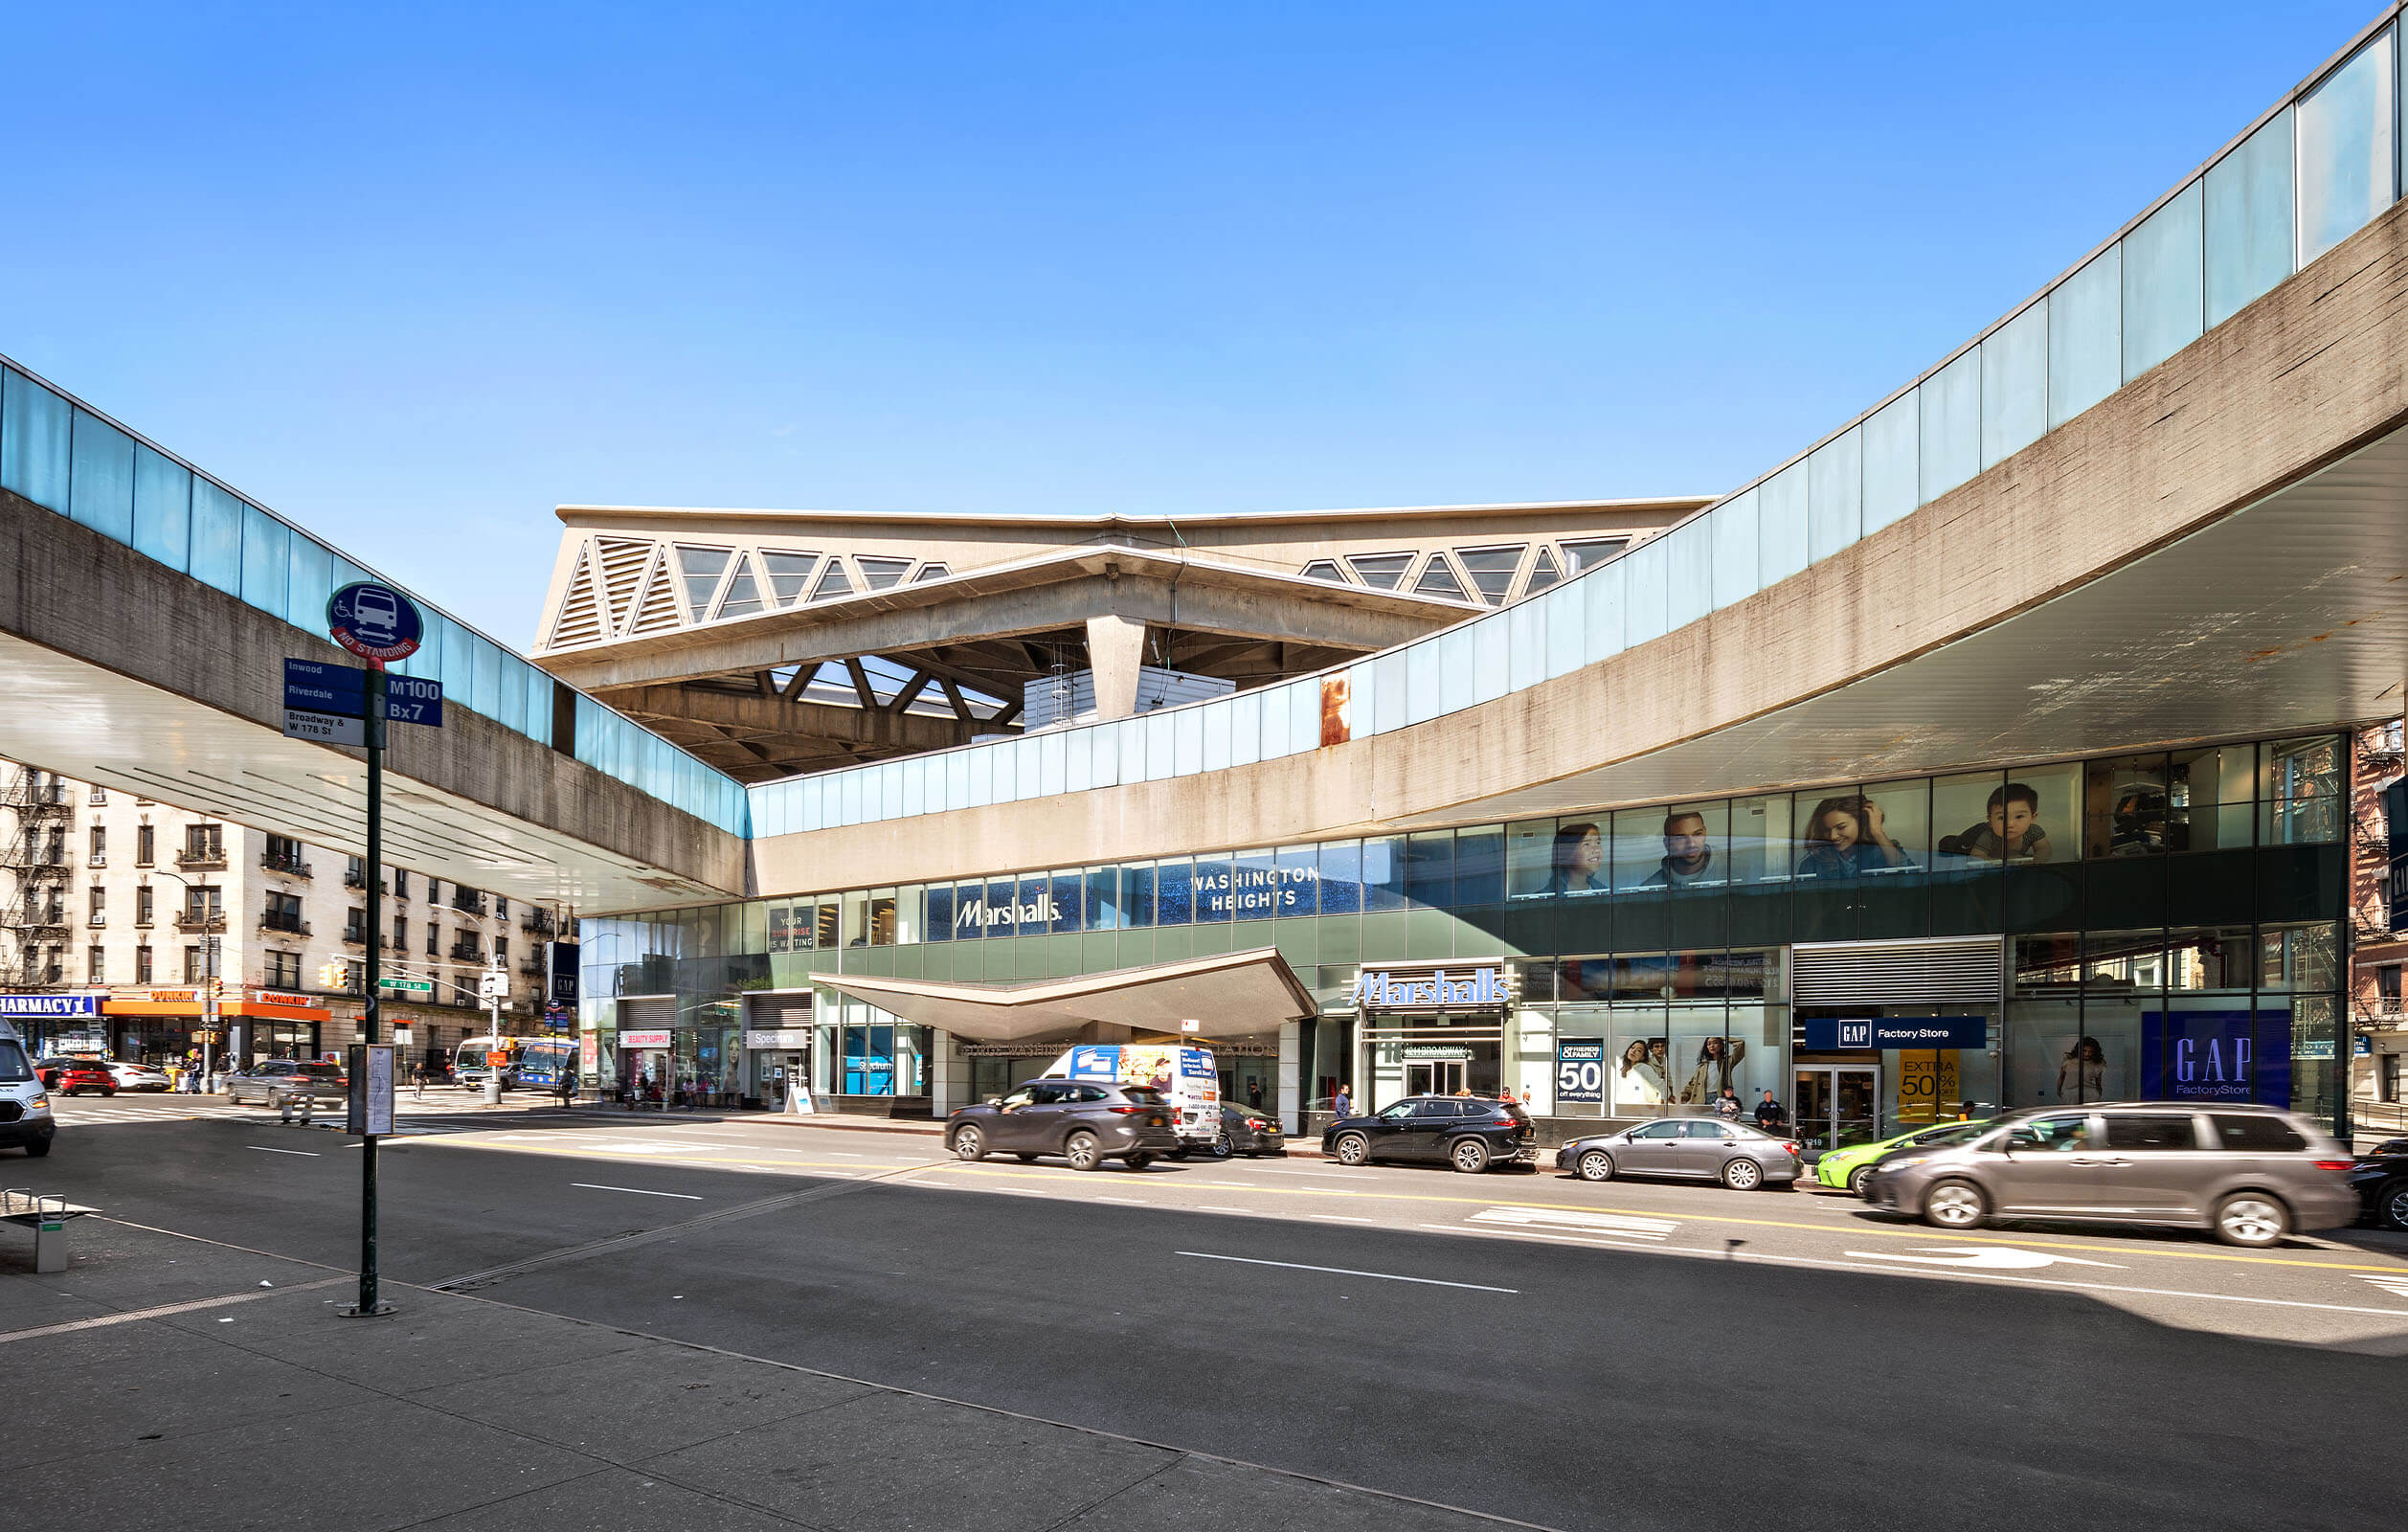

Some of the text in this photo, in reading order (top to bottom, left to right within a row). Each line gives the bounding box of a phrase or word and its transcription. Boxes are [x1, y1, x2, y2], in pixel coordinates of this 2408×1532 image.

[338, 633, 356, 646] NO
[357, 642, 412, 657] STANDING
[288, 662, 323, 674] Inwood
[288, 685, 333, 700] Riverdale
[390, 680, 439, 700] M100
[289, 711, 345, 727] Broadway &
[390, 704, 424, 720] Bx7
[289, 722, 331, 735] W 178 St
[1190, 866, 1318, 890] WASHINGTON
[2395, 866, 2408, 896] GA
[1211, 890, 1295, 911] HEIGHTS
[780, 917, 802, 926] YOUR
[772, 927, 811, 936] SURRISE
[780, 938, 813, 948] WATING
[557, 980, 574, 991] GAP
[1348, 968, 1510, 1005] Marshalls
[628, 1034, 668, 1044] BEAUTY SUPPLY
[755, 1034, 793, 1046] Spectrum
[1843, 1025, 1867, 1042] GAP
[1878, 1028, 1949, 1039] Factory Store
[1422, 1047, 1463, 1056] BROADWAY
[1904, 1061, 1954, 1072] EXTRA
[2176, 1038, 2250, 1082] GAP
[1559, 1063, 1601, 1091] 50
